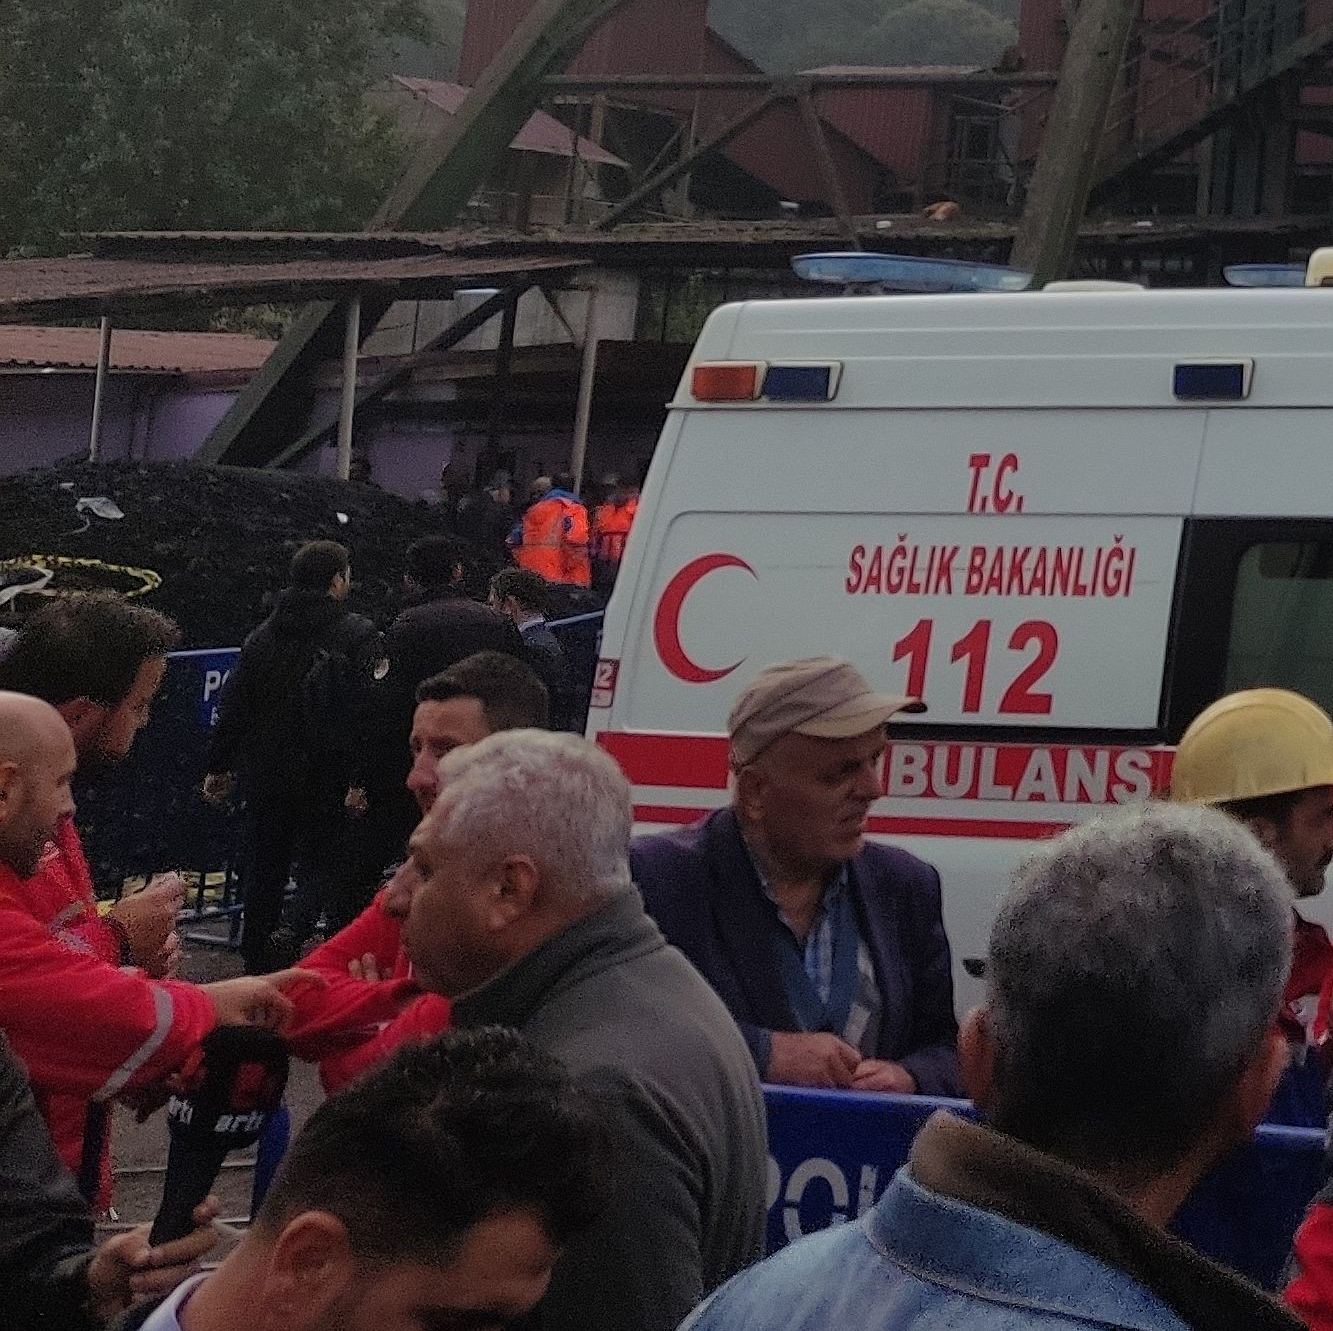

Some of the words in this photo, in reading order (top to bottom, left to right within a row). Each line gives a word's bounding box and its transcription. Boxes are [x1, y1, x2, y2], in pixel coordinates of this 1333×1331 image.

[968, 453, 1024, 513] T.C.
[846, 532, 960, 596] SAĞLIK
[964, 534, 1137, 598] BAKANLIĞI
[892, 618, 1059, 715] 112
[877, 745, 1152, 805] BULANS
